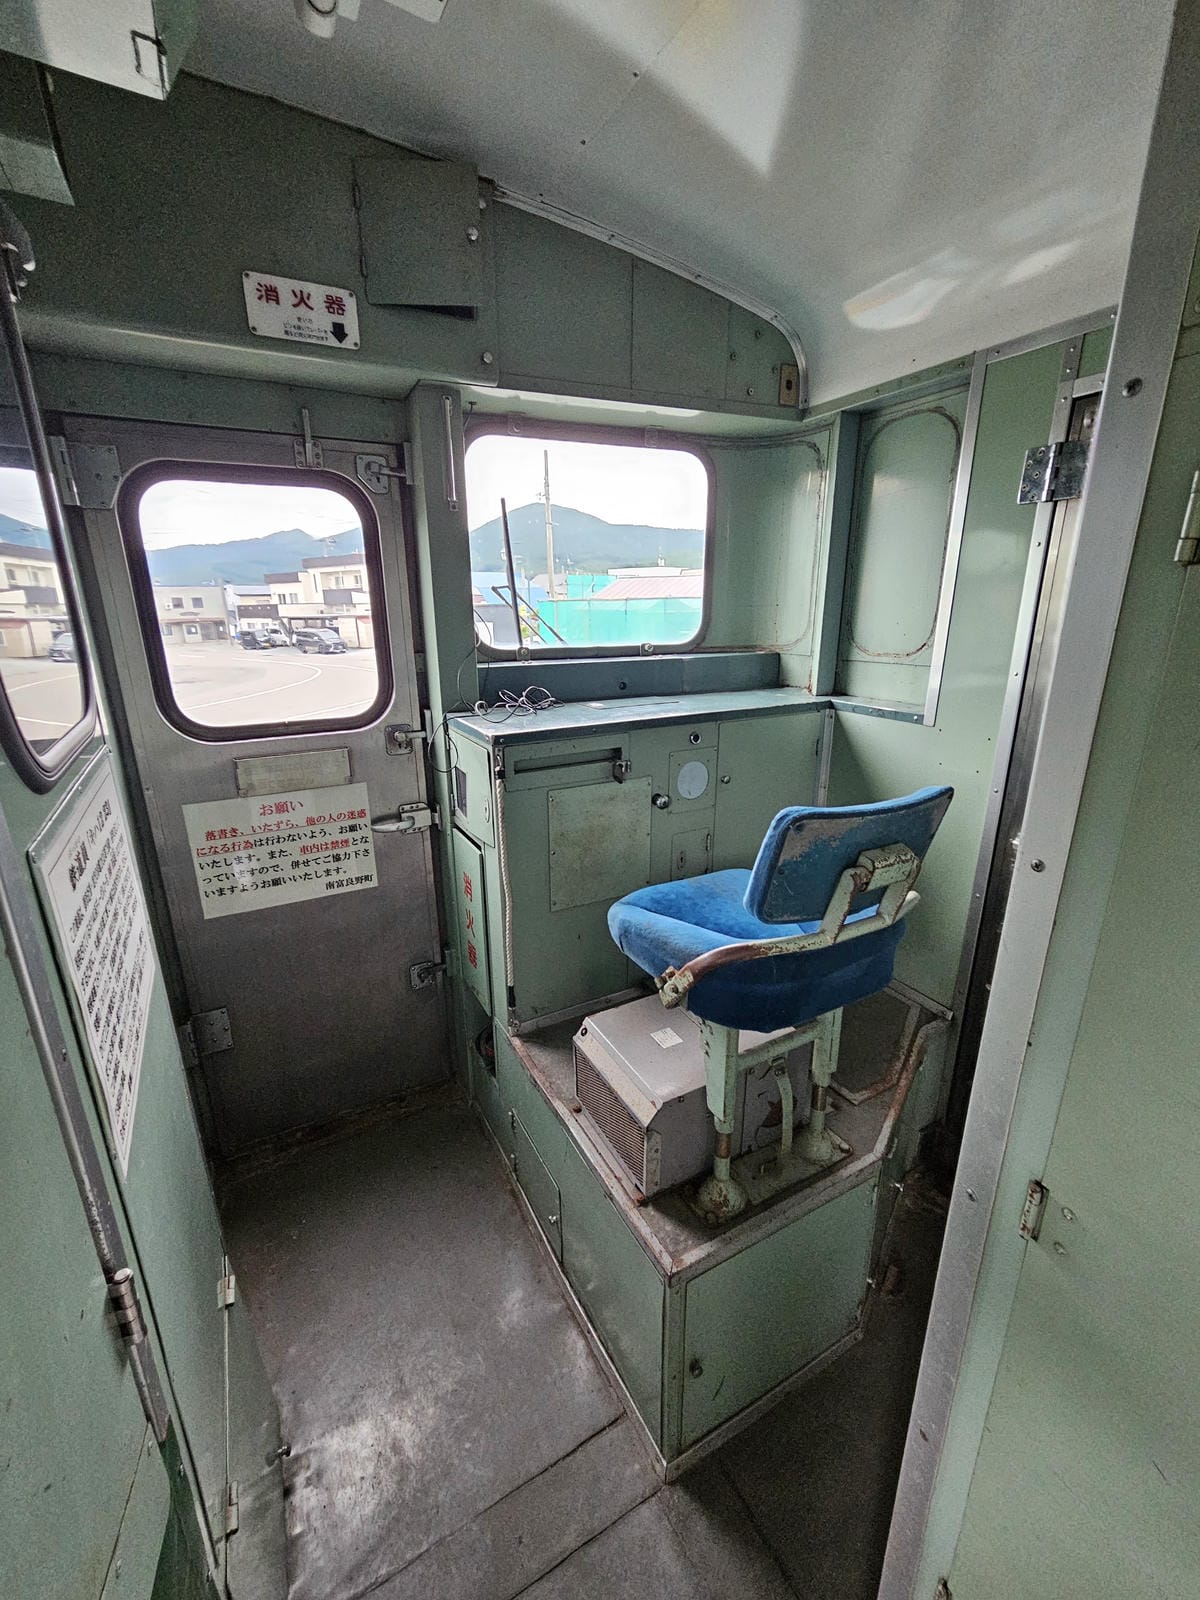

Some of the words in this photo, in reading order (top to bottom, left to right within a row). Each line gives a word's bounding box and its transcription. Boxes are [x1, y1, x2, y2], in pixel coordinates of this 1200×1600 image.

[256, 282, 347, 316] 消火器
[204, 808, 367, 842] 落書き、いたずら、他の人の迷惑
[259, 800, 304, 816] お願い
[195, 822, 369, 857] になる行為は行わないよう、お願い
[199, 835, 370, 870] いたします。また、車内は禁煙とな
[202, 848, 371, 884] っていますので、併せてご協力下さ
[204, 867, 348, 898] いますようお願いいたします。
[325, 874, 374, 890] 南富良野町
[463, 871, 477, 968] 消火器
